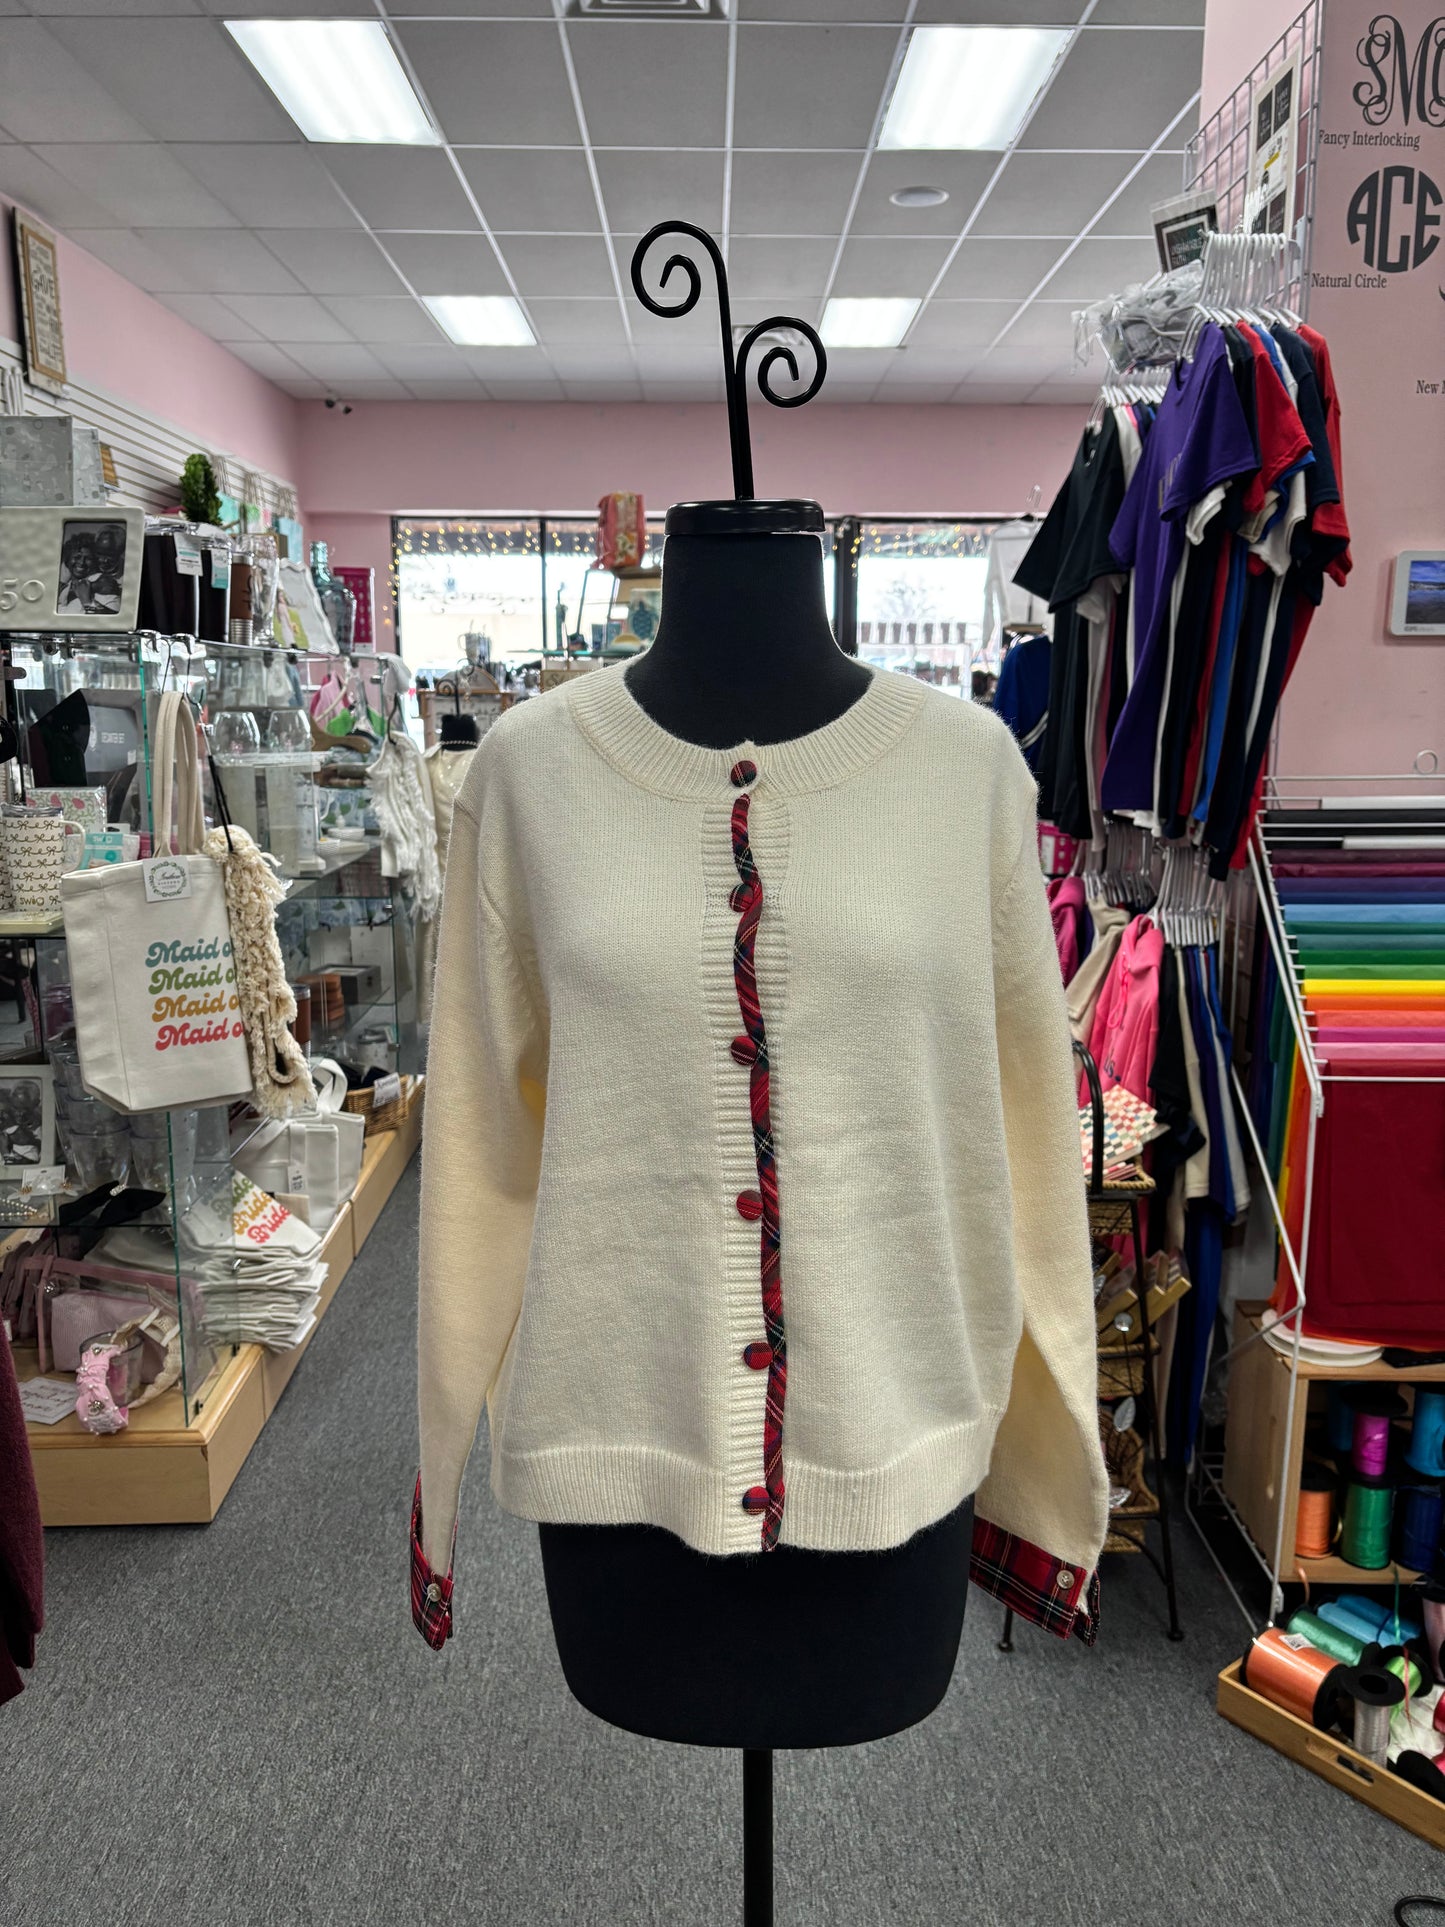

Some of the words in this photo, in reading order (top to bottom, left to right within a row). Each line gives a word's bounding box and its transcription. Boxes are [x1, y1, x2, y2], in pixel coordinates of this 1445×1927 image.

[1319, 130, 1350, 149] Fancy
[1352, 131, 1420, 151] Interlocking
[1346, 165, 1443, 273] ACE
[1311, 272, 1352, 288] Natural
[1354, 273, 1387, 288] Circle
[1416, 380, 1439, 394] New
[145, 937, 220, 968] Maid
[148, 963, 223, 995] Maid
[152, 990, 227, 1023] Maid
[155, 1017, 230, 1051] Maid
[232, 1191, 273, 1235] Bride
[247, 1204, 291, 1244] Bride
